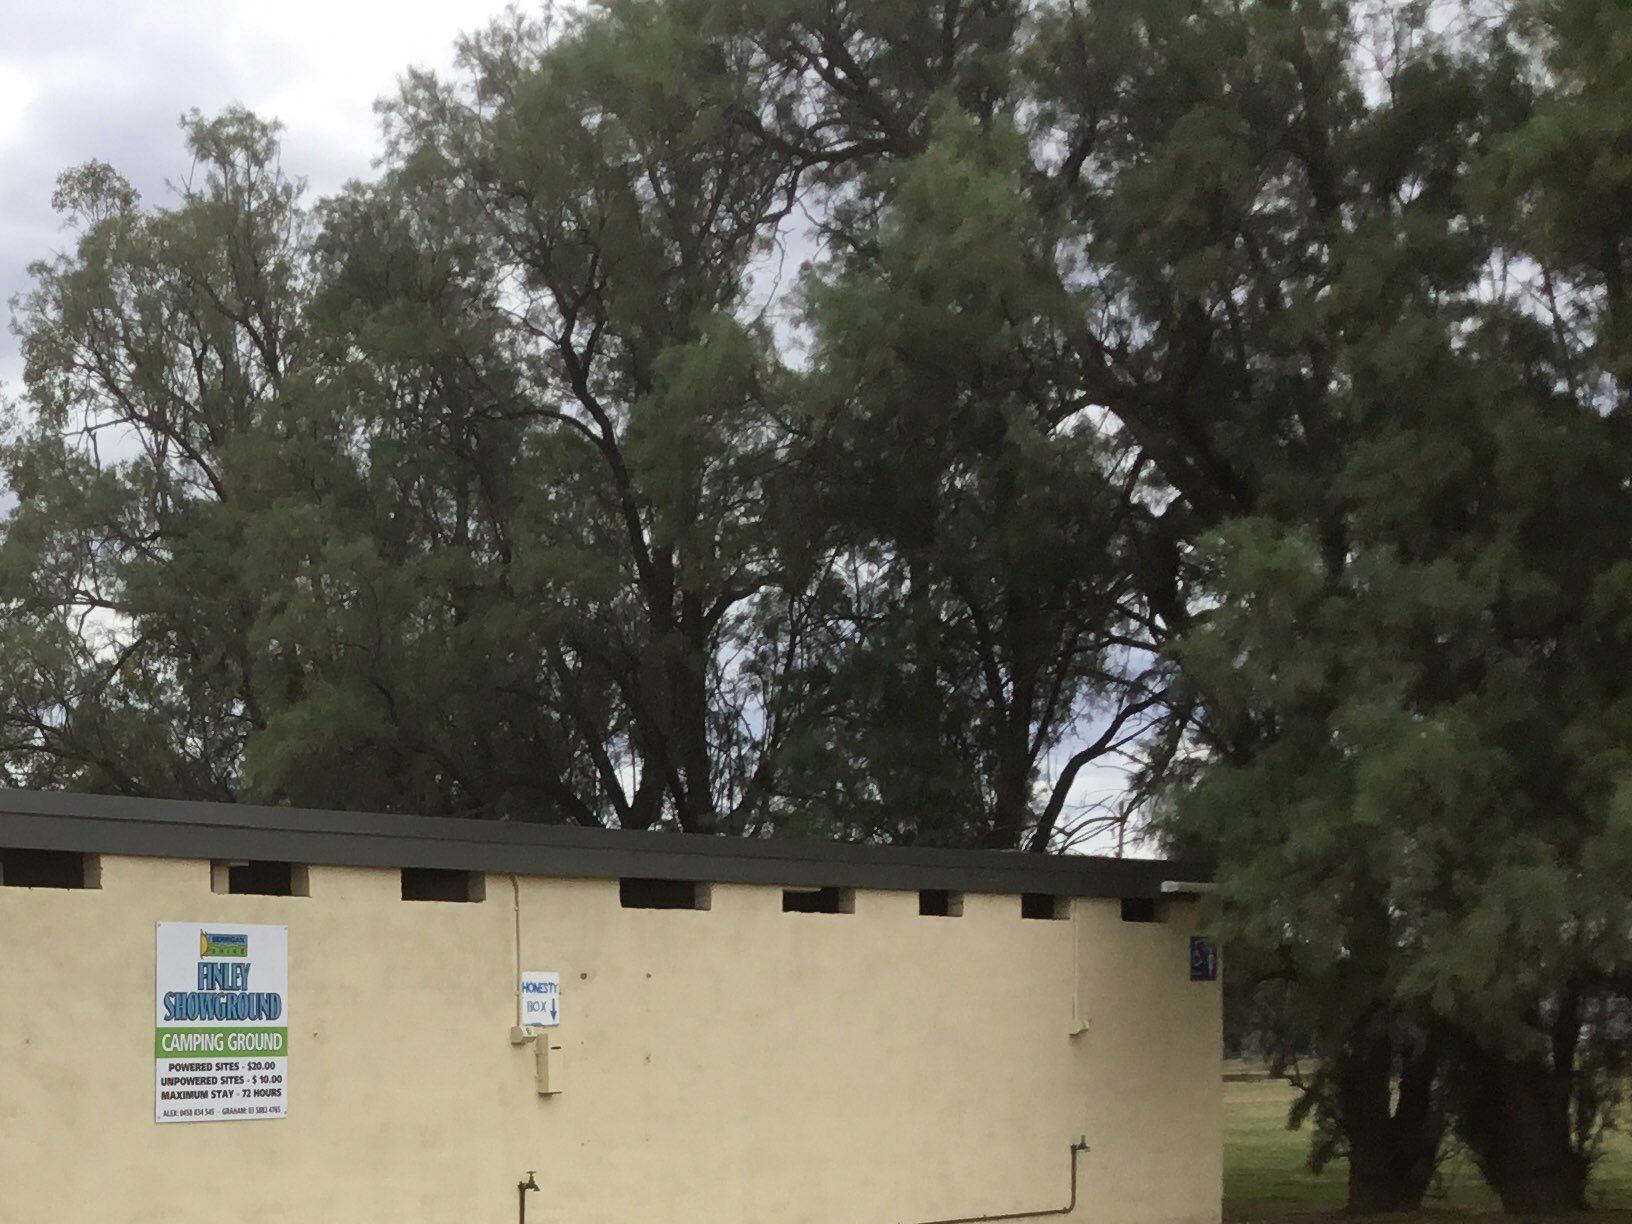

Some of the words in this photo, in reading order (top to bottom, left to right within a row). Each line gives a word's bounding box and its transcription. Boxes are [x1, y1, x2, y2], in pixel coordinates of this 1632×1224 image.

[197, 962, 251, 991] FINLEY
[521, 981, 559, 994] HONESTY
[163, 991, 282, 1021] SHOWGROUND
[527, 1000, 547, 1012] BOX
[161, 1033, 224, 1052] CAMPING
[228, 1032, 283, 1051] GROUND
[168, 1062, 213, 1072] POWERED
[215, 1062, 239, 1071] SITES
[247, 1061, 276, 1071] $20.00
[160, 1076, 218, 1086] UNPOWERED
[220, 1075, 245, 1085] SITES
[160, 1090, 209, 1100] MAXIMUM
[210, 1089, 234, 1099] STAY
[242, 1089, 251, 1098] 72
[253, 1088, 282, 1098] HOURS
